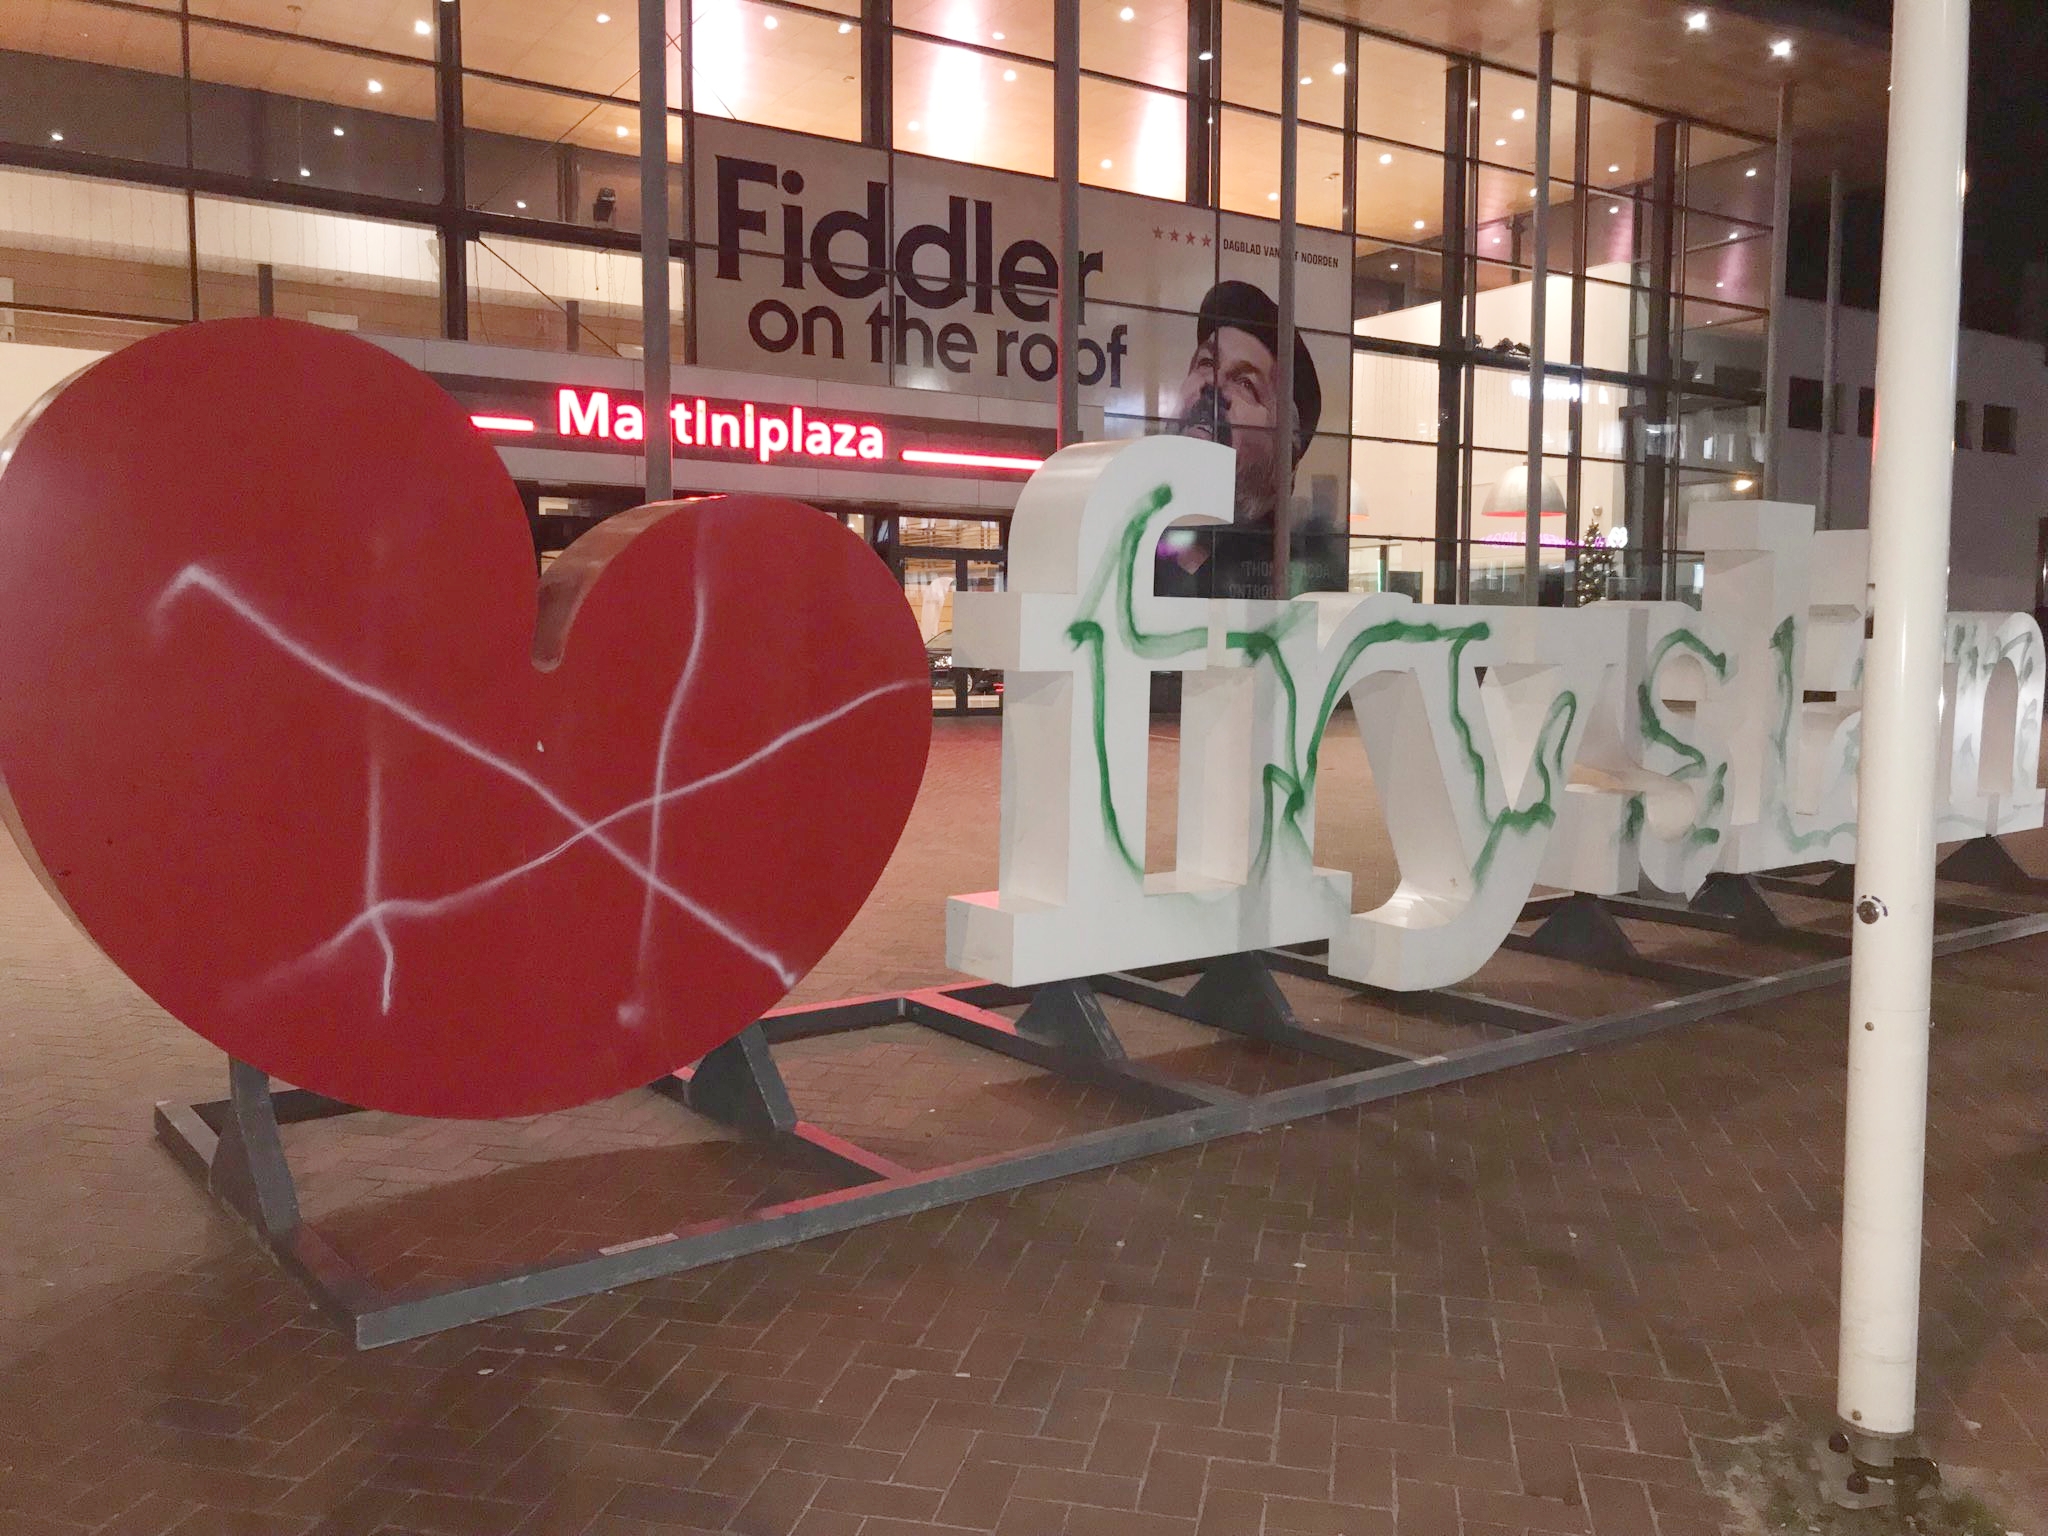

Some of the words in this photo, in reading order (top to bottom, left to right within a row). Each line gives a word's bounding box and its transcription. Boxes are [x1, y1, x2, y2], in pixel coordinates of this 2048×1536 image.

[715, 154, 1103, 326] Fiddler
[1223, 239, 1261, 256] DAGBLAD
[1301, 251, 1339, 268] NOORDEN
[748, 299, 845, 360] on
[865, 295, 978, 374] the
[996, 323, 1128, 389] roof
[557, 388, 884, 463] Matiniplaza
[945, 432, 2047, 994] frysln
